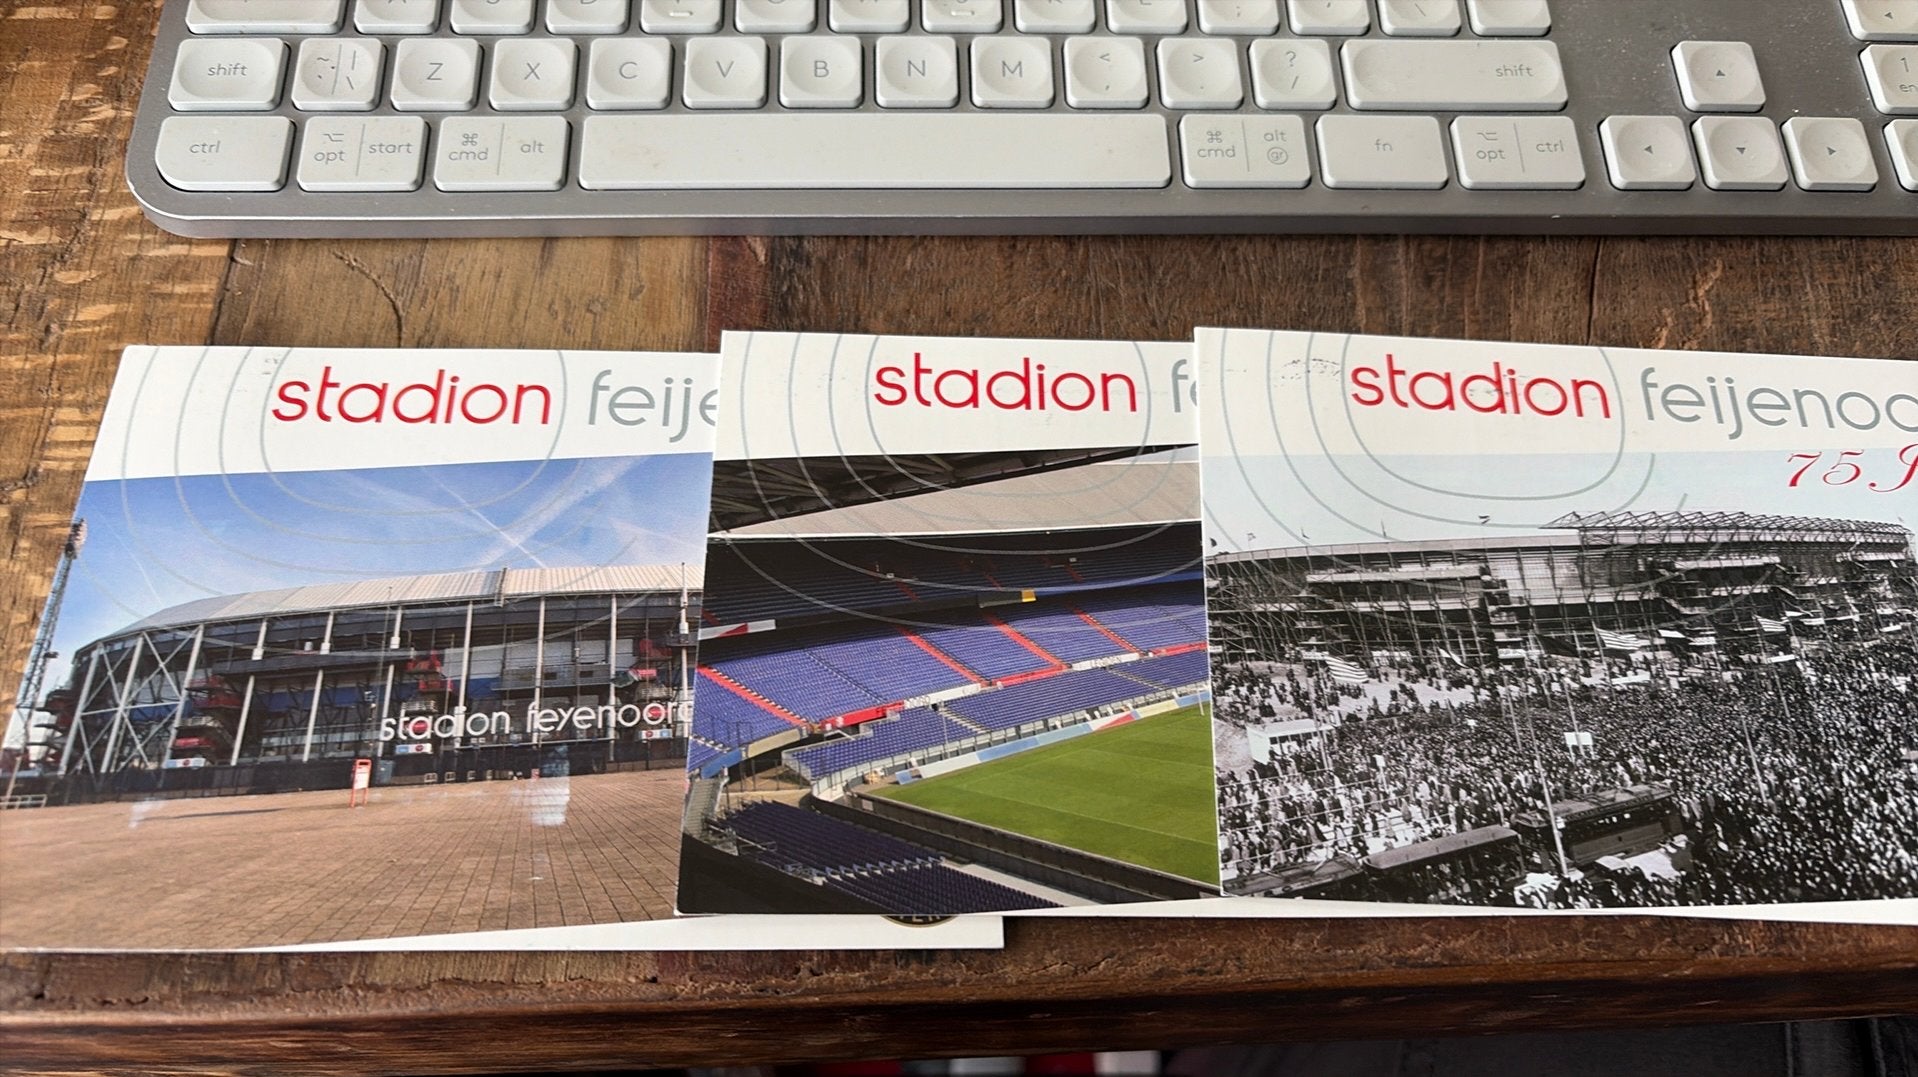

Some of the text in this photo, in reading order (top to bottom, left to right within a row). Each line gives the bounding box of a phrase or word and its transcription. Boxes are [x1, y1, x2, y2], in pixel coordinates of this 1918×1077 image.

[907, 59, 926, 77] N
[1285, 50, 1297, 68] ?
[207, 62, 248, 77] shift
[426, 62, 444, 81] Z
[523, 62, 541, 81] X
[618, 61, 638, 80] C
[715, 60, 735, 79] V
[813, 60, 830, 78] B
[1001, 60, 1024, 78] M
[1495, 63, 1534, 78] shift
[1263, 129, 1287, 143] alt
[1374, 138, 1394, 152] fn
[189, 140, 221, 154] ctrl
[368, 140, 413, 154] start
[448, 147, 489, 162] cmd
[520, 139, 545, 154] alt
[1197, 145, 1236, 159] cmd
[1536, 139, 1565, 153] ctrl
[313, 148, 346, 165] opt
[1476, 148, 1507, 163] opt
[874, 352, 1198, 413] stadion f
[1350, 353, 1611, 419] stadion
[272, 366, 552, 424] stadion
[1787, 450, 1865, 487] 75
[380, 705, 511, 742] stadion
